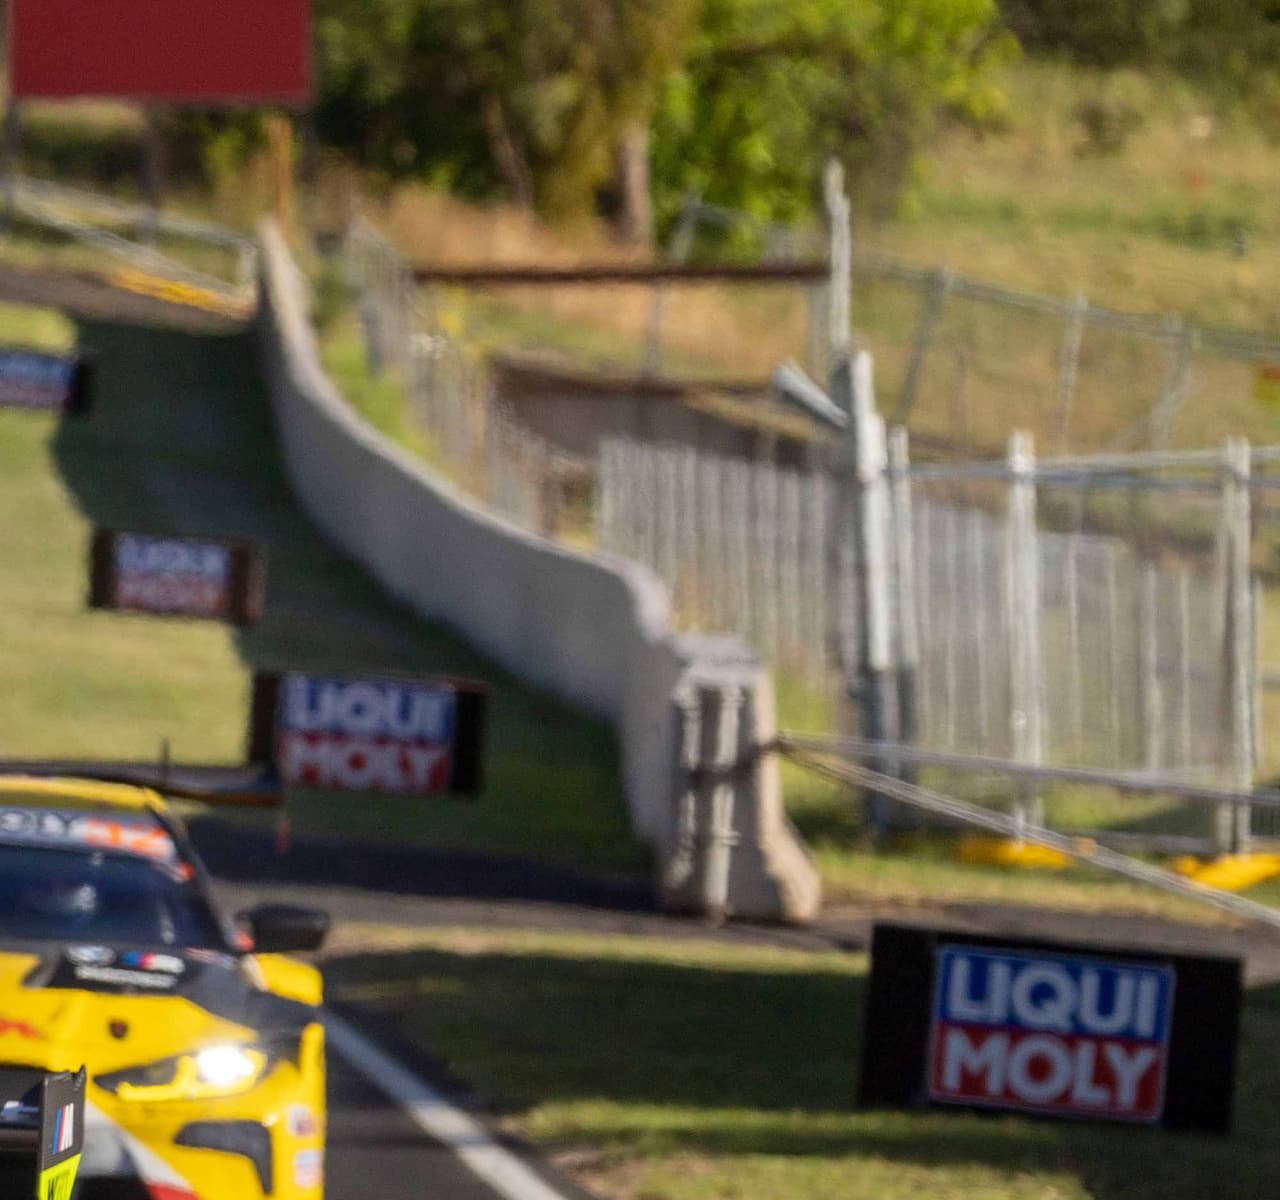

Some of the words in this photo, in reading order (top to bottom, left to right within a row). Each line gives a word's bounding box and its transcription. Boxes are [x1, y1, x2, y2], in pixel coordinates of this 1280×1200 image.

[288, 676, 455, 741] LIQUI
[285, 736, 448, 791] MOLY
[947, 957, 1159, 1037] LIQUI
[942, 1029, 1158, 1110] MOLY
